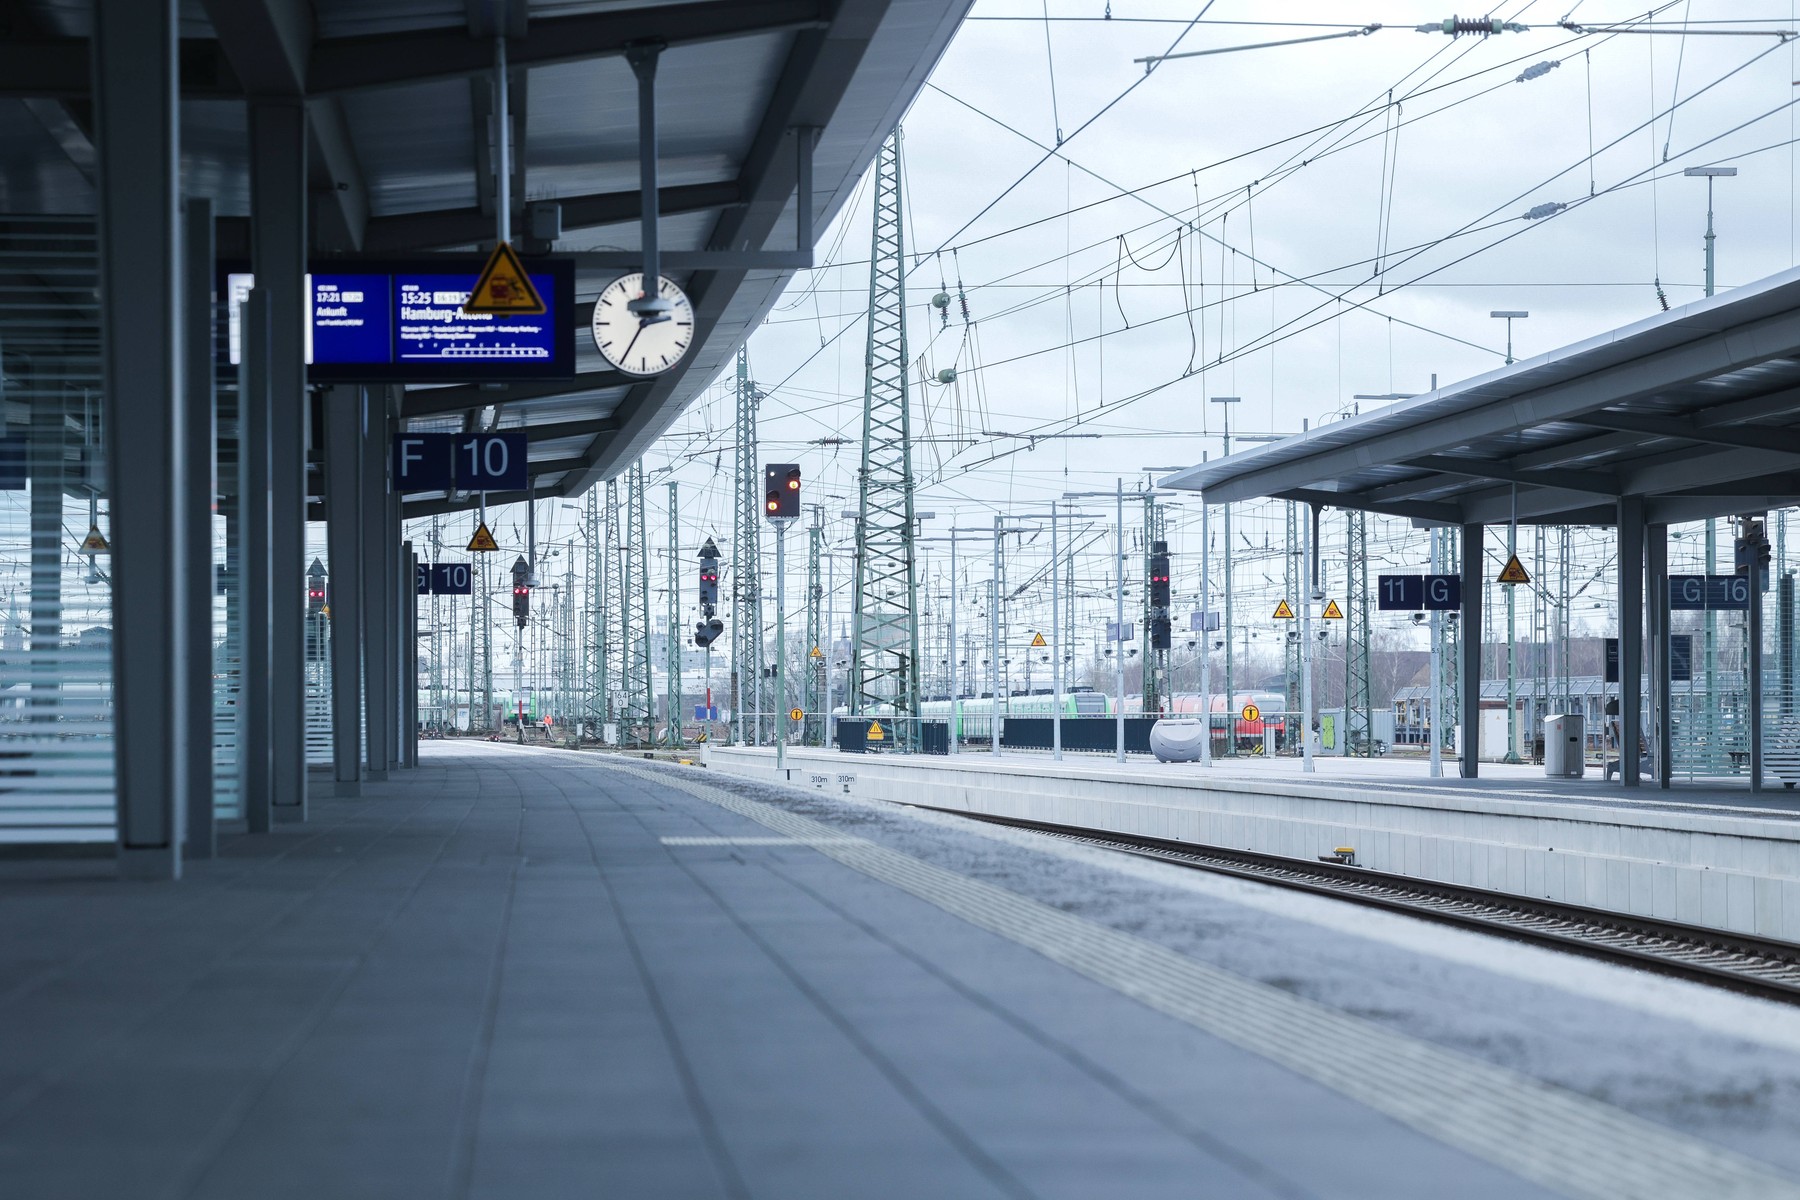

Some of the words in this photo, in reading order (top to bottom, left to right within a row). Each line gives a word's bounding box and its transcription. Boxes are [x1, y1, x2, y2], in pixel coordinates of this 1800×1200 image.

[316, 292, 340, 303] 17:21
[401, 292, 432, 304] 15:25
[401, 439, 424, 477] F
[463, 438, 509, 477] 10
[442, 566, 467, 588] 10
[1384, 578, 1405, 602] 11
[1430, 578, 1449, 602] G
[1682, 578, 1701, 602] G
[1719, 578, 1748, 602] 16
[811, 775, 828, 783] 310m
[838, 775, 855, 783] 310m
